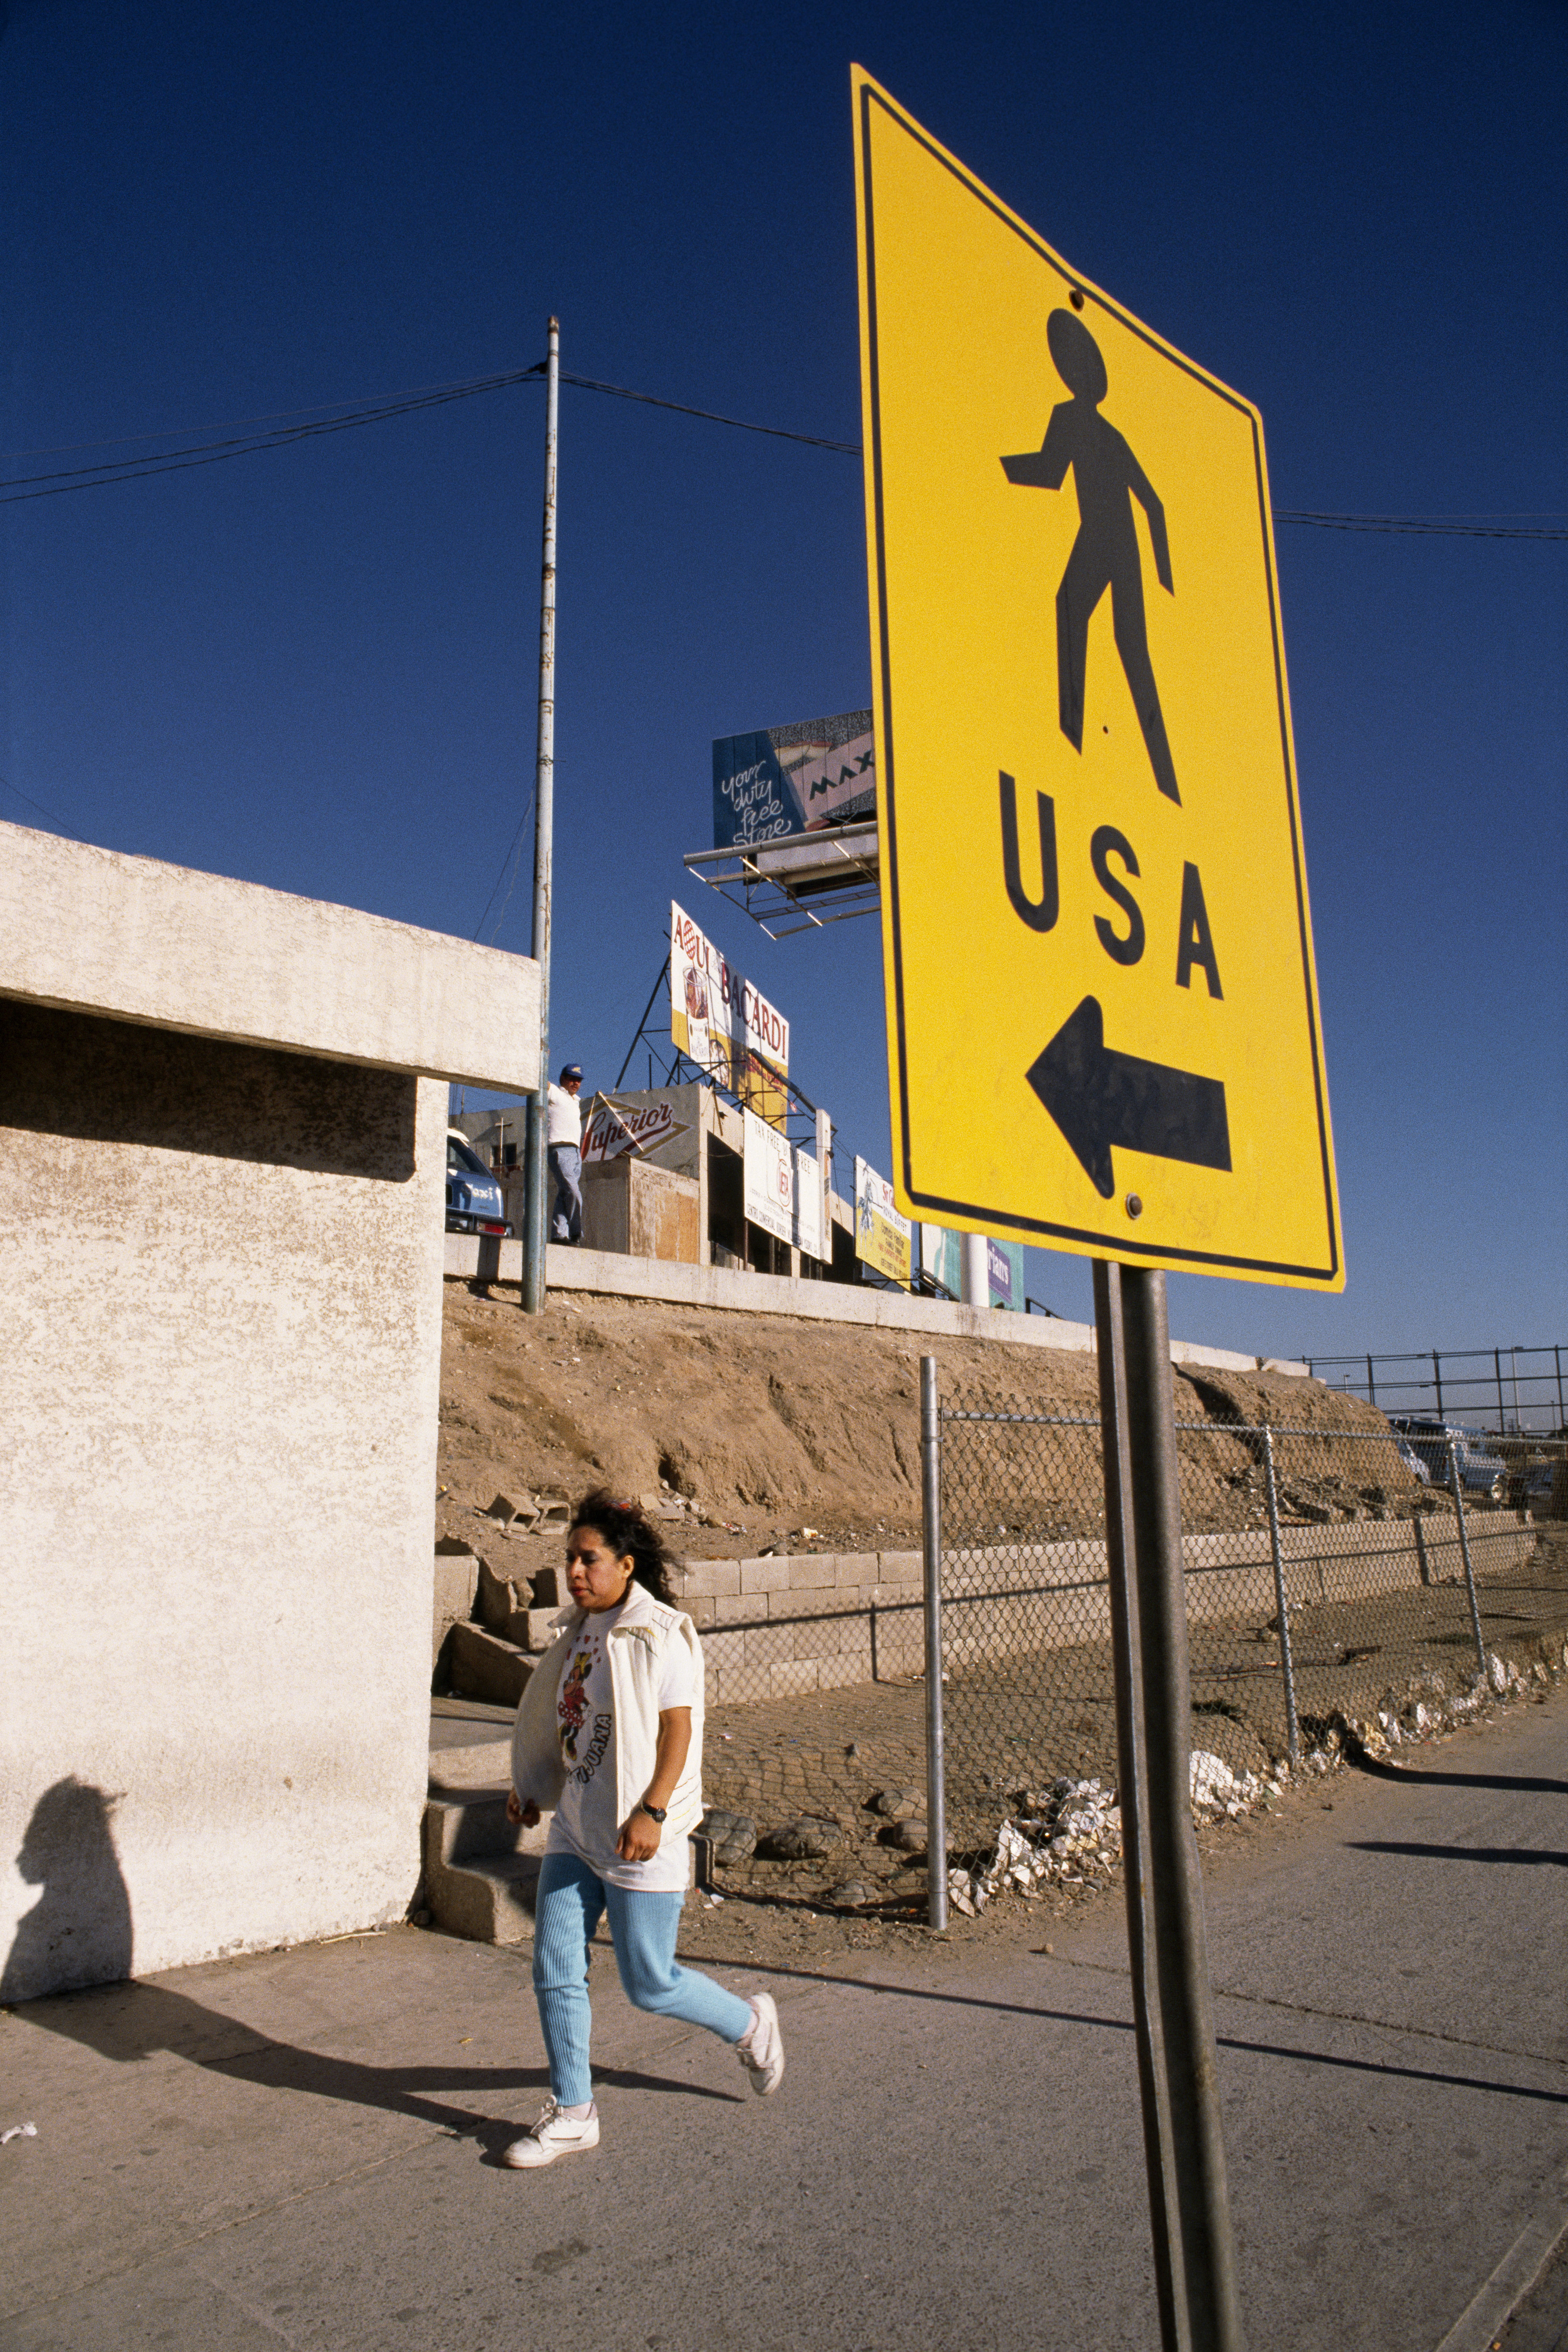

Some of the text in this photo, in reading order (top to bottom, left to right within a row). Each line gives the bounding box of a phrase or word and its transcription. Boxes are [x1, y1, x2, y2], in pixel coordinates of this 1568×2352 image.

[722, 760, 766, 801] your
[734, 780, 772, 812] duty
[742, 800, 783, 836] free
[998, 769, 1224, 1001] USA
[721, 961, 786, 1060] BACARDI
[582, 1103, 673, 1160] Superior
[754, 1120, 765, 1141] TAX
[767, 1129, 780, 1152] FREE
[797, 1153, 810, 1174] FREE
[570, 1713, 613, 1784] TIJUANA
